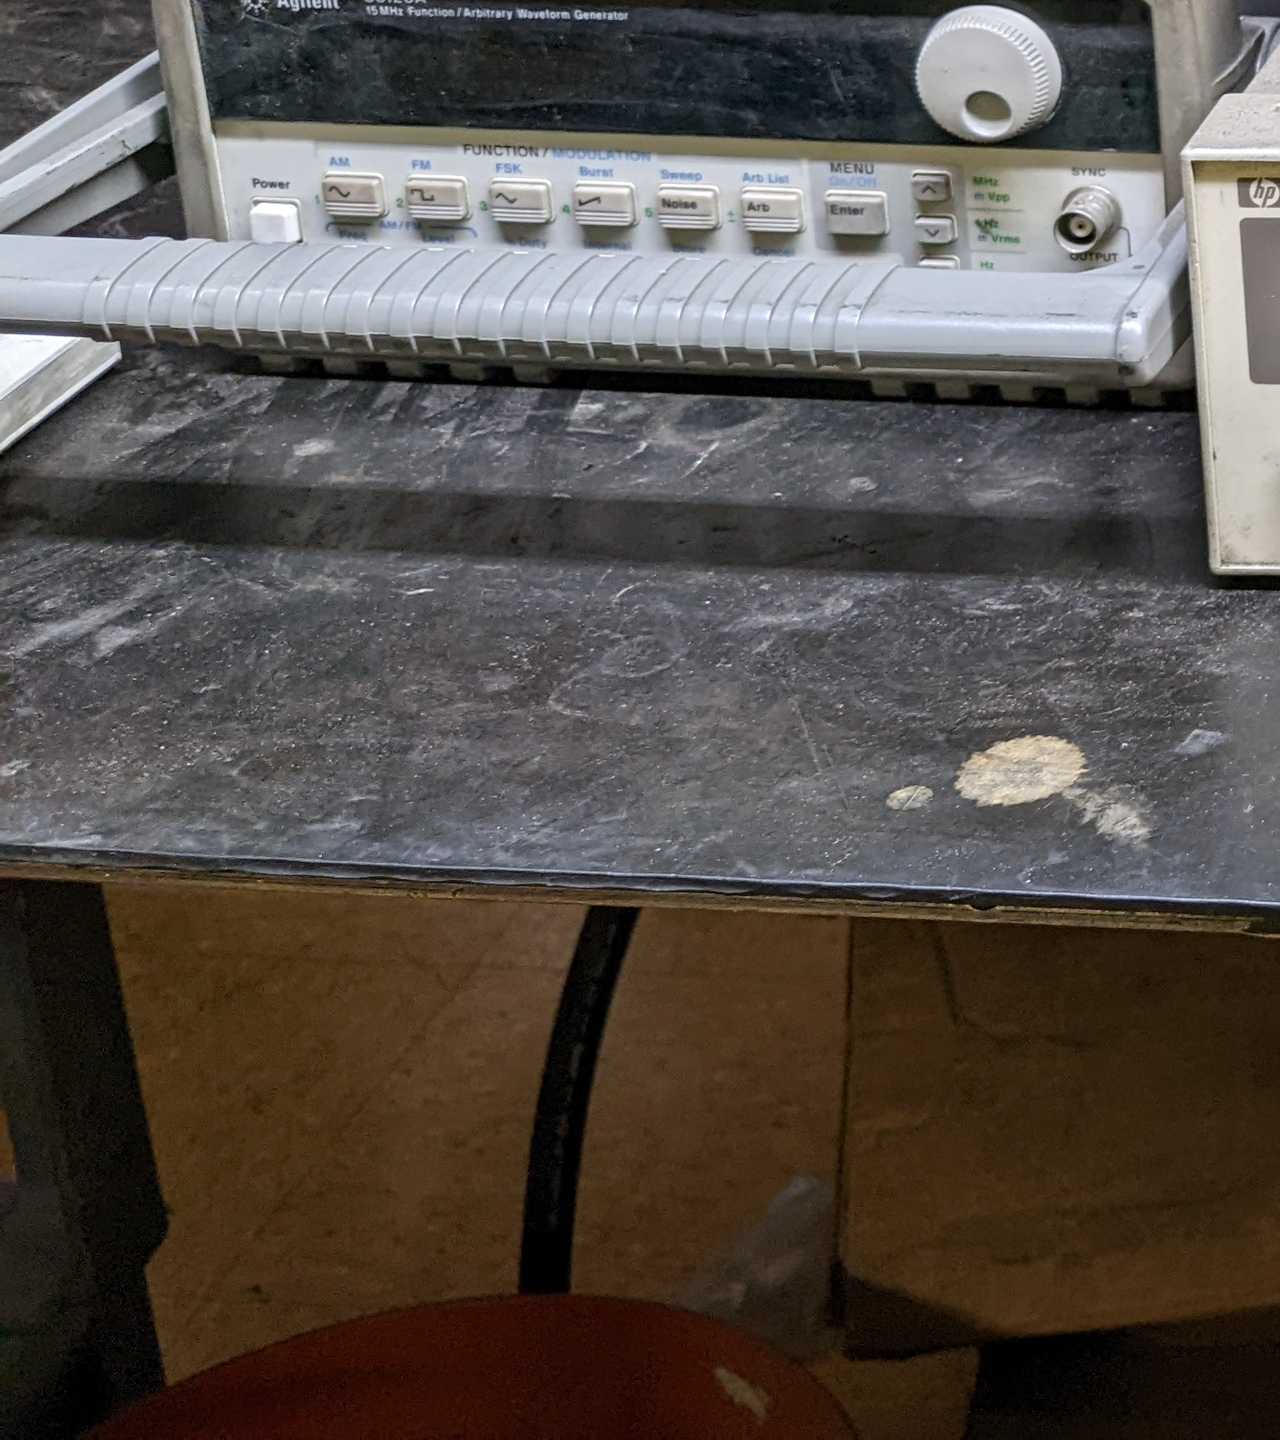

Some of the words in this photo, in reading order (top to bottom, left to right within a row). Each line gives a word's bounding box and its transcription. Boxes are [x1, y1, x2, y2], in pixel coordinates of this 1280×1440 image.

[516, 8, 571, 21] Waveform
[573, 9, 629, 22] Generator
[463, 144, 539, 157] FUNCTION
[550, 146, 652, 162] MODULATION
[329, 157, 351, 167] AM
[412, 160, 432, 170] FM
[495, 163, 522, 174] FSK
[579, 166, 614, 178] Burst
[829, 162, 875, 175] MENU
[1071, 166, 1106, 177] SYNC
[659, 169, 703, 182] Sweep
[742, 172, 764, 183] Arb
[768, 173, 789, 184] List
[251, 178, 291, 190] Power
[661, 198, 698, 210] Noise
[747, 201, 771, 213] Arb
[829, 204, 865, 216] Enter
[1070, 252, 1118, 262] OUTPUT
